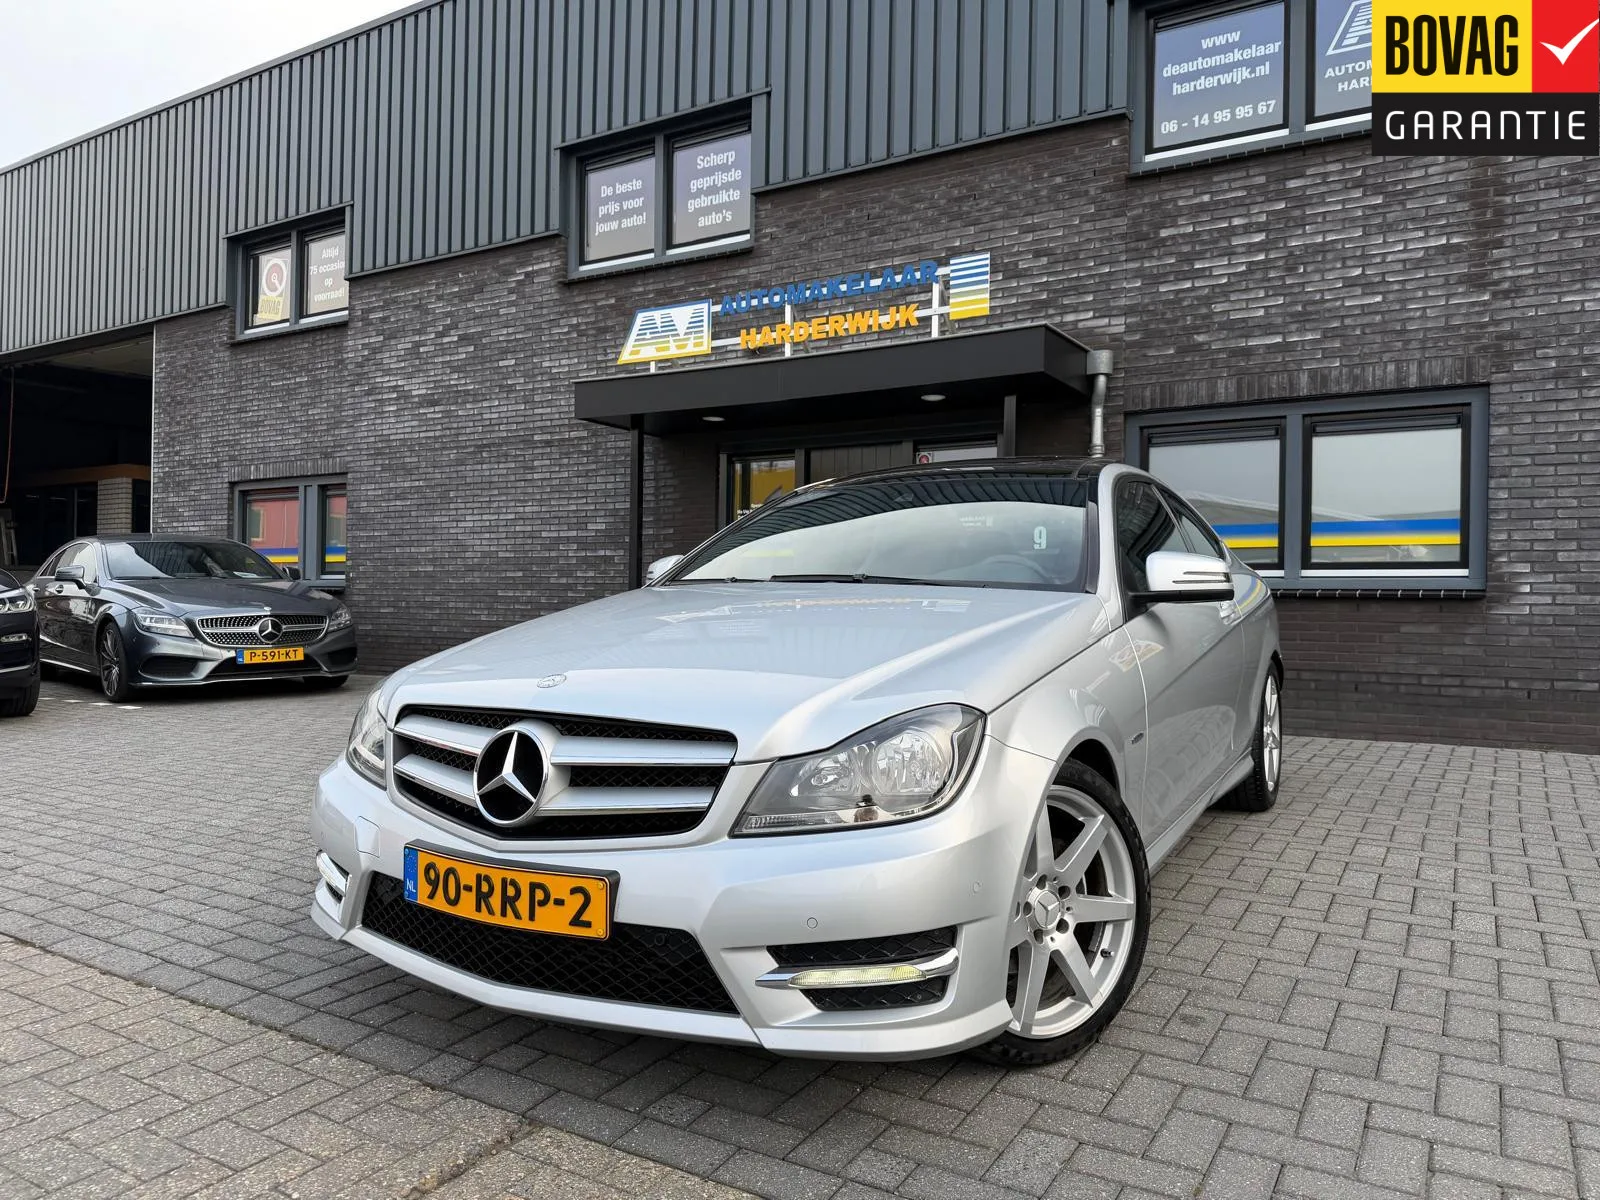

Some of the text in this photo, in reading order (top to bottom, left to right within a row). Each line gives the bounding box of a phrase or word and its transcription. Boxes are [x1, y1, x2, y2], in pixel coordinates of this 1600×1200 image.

[1201, 31, 1241, 50] www
[1162, 41, 1282, 78] deautomakelaar
[1172, 62, 1270, 96] harderwijk.nl
[1337, 76, 1372, 92] HAR
[1160, 120, 1180, 134] 06
[1192, 114, 1210, 128] 14
[1213, 109, 1232, 124] 95
[1234, 104, 1254, 119] 95
[1257, 100, 1276, 115] 67
[696, 150, 736, 170] Scherp
[600, 178, 642, 198] De beste
[690, 168, 742, 192] geprijsde
[598, 195, 645, 217] prijs voor
[688, 189, 740, 212] gebruikte
[595, 212, 647, 236] jouw auto!
[698, 209, 733, 227] auto's
[321, 246, 339, 259] Altijd
[324, 277, 333, 288] op
[718, 260, 938, 316] AUTOMAKELAAR
[739, 303, 919, 350] HARDERWIJK
[1033, 526, 1047, 549] 9
[249, 649, 298, 662] P-591-KT
[406, 861, 593, 929] NL 90-RRP-2
